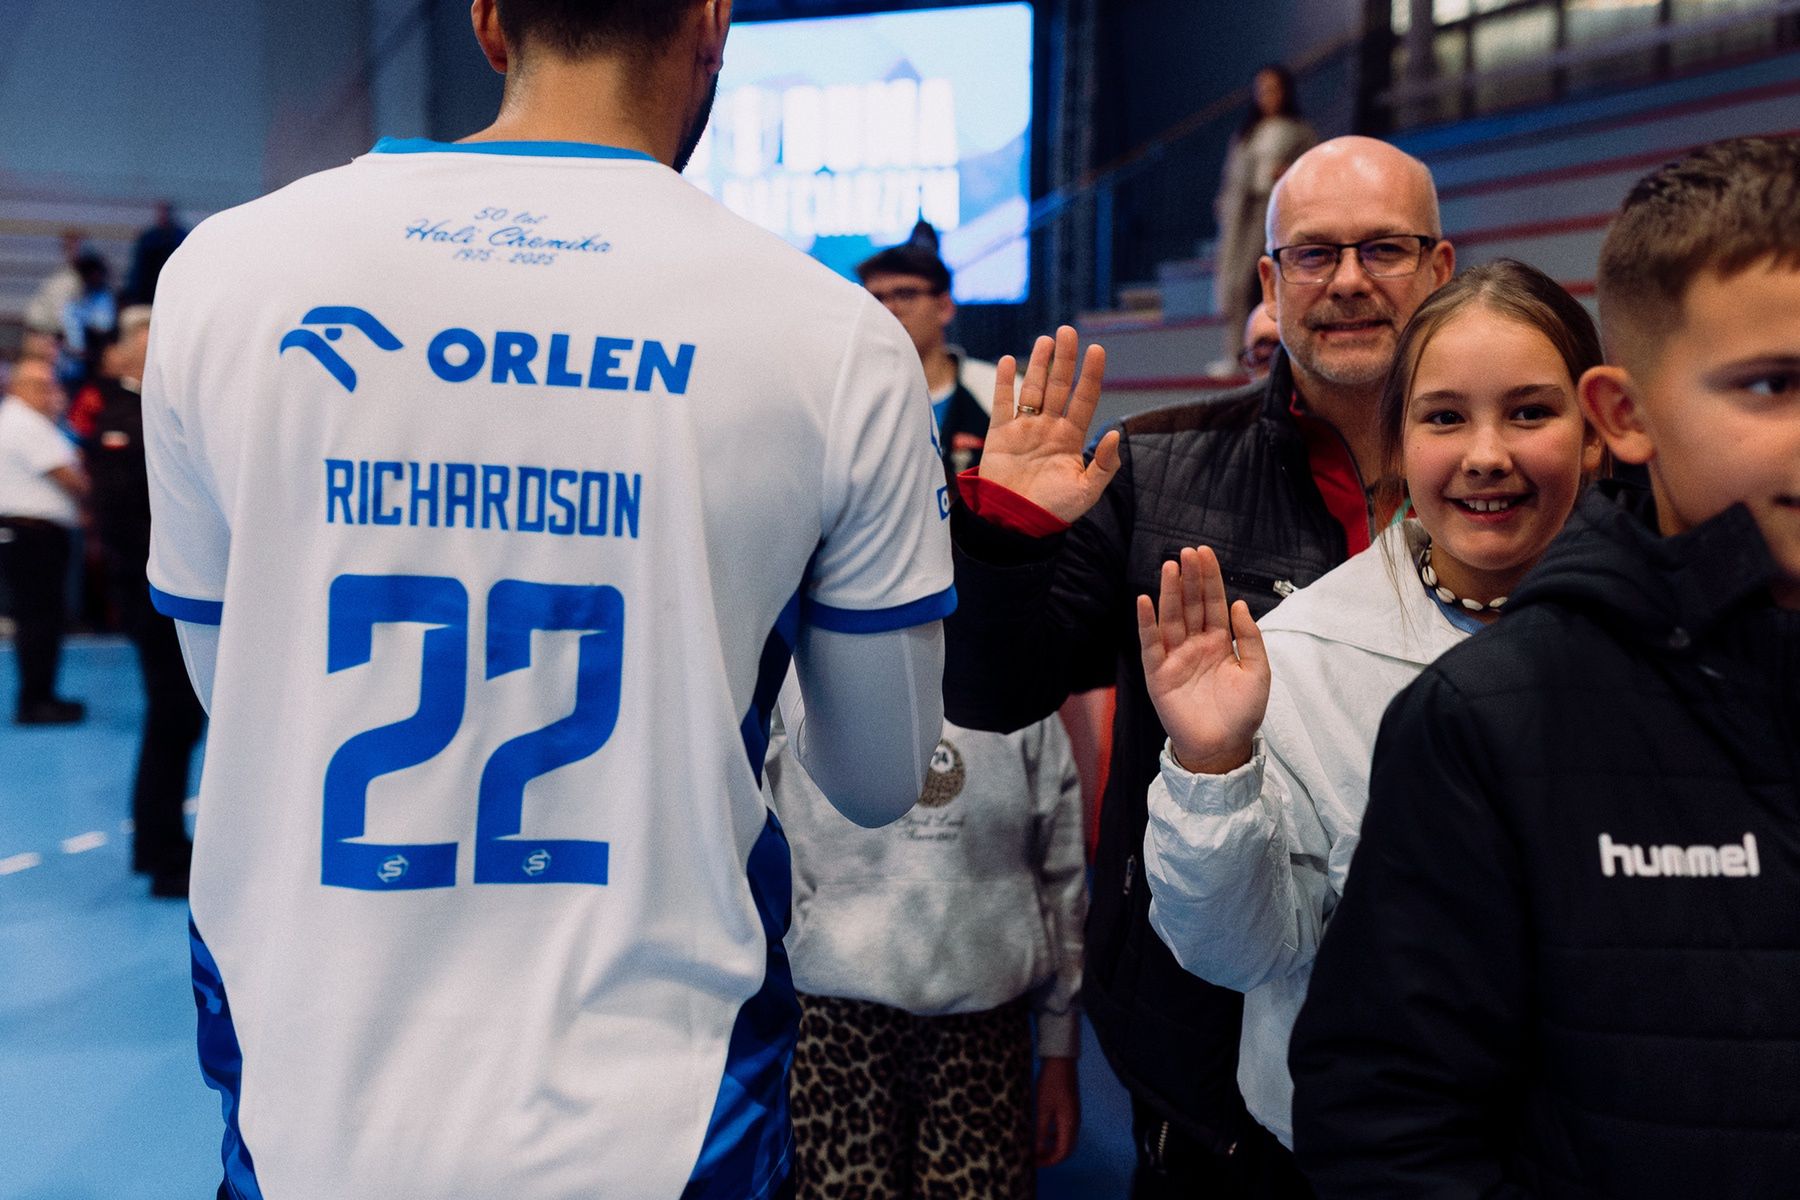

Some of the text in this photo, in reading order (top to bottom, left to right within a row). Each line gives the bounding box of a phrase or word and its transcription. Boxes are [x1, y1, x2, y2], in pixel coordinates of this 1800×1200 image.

[405, 219, 611, 252] Hali Chemika
[474, 207, 508, 221] 50
[427, 327, 696, 395] ORLEN
[325, 459, 641, 538] RICHARDSON
[321, 573, 625, 891] 22
[1598, 832, 1760, 877] hummel
